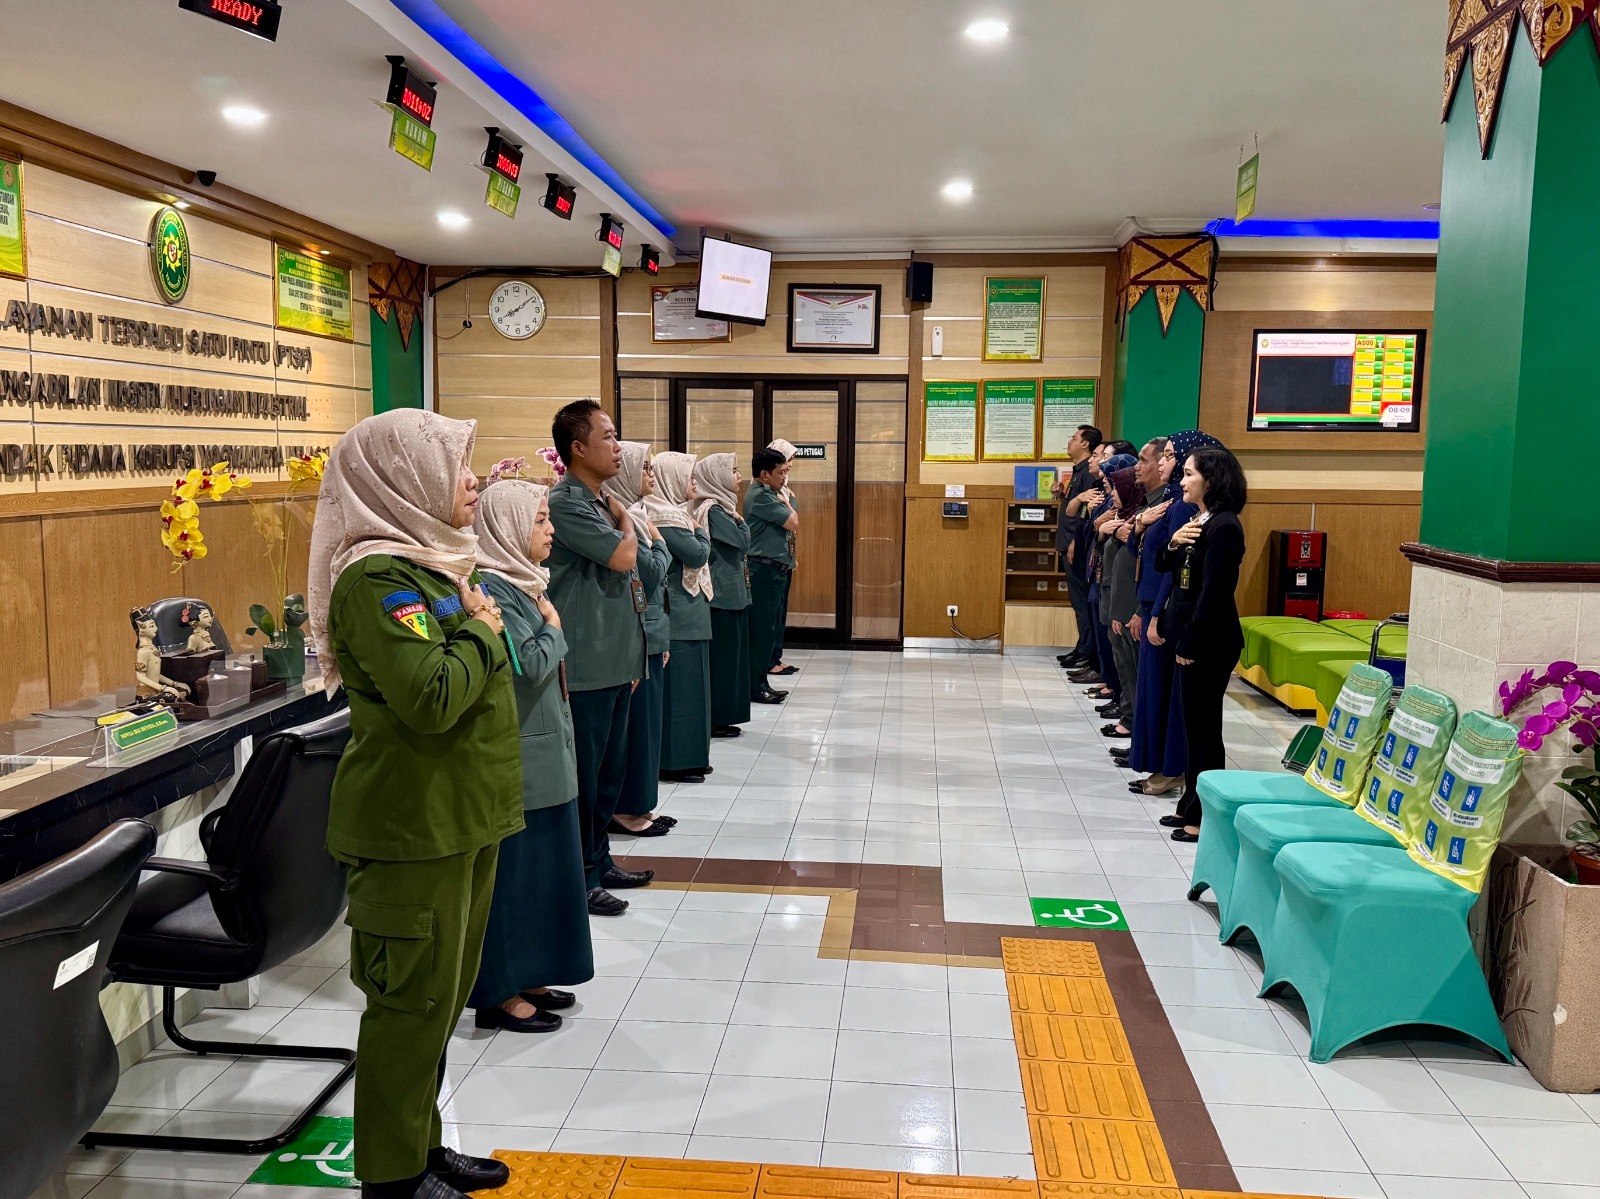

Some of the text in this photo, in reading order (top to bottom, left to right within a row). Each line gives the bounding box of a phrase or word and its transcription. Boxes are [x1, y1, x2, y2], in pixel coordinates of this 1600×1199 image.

[211, 0, 263, 25] READY
[0, 300, 94, 340] AYANAN
[97, 314, 184, 351] TERPADU
[185, 329, 228, 358] SATU
[228, 336, 271, 365] PINTU
[127, 444, 196, 471] KORUPSI
[804, 447, 824, 456] PETUGAS
[406, 616, 425, 628] P S
